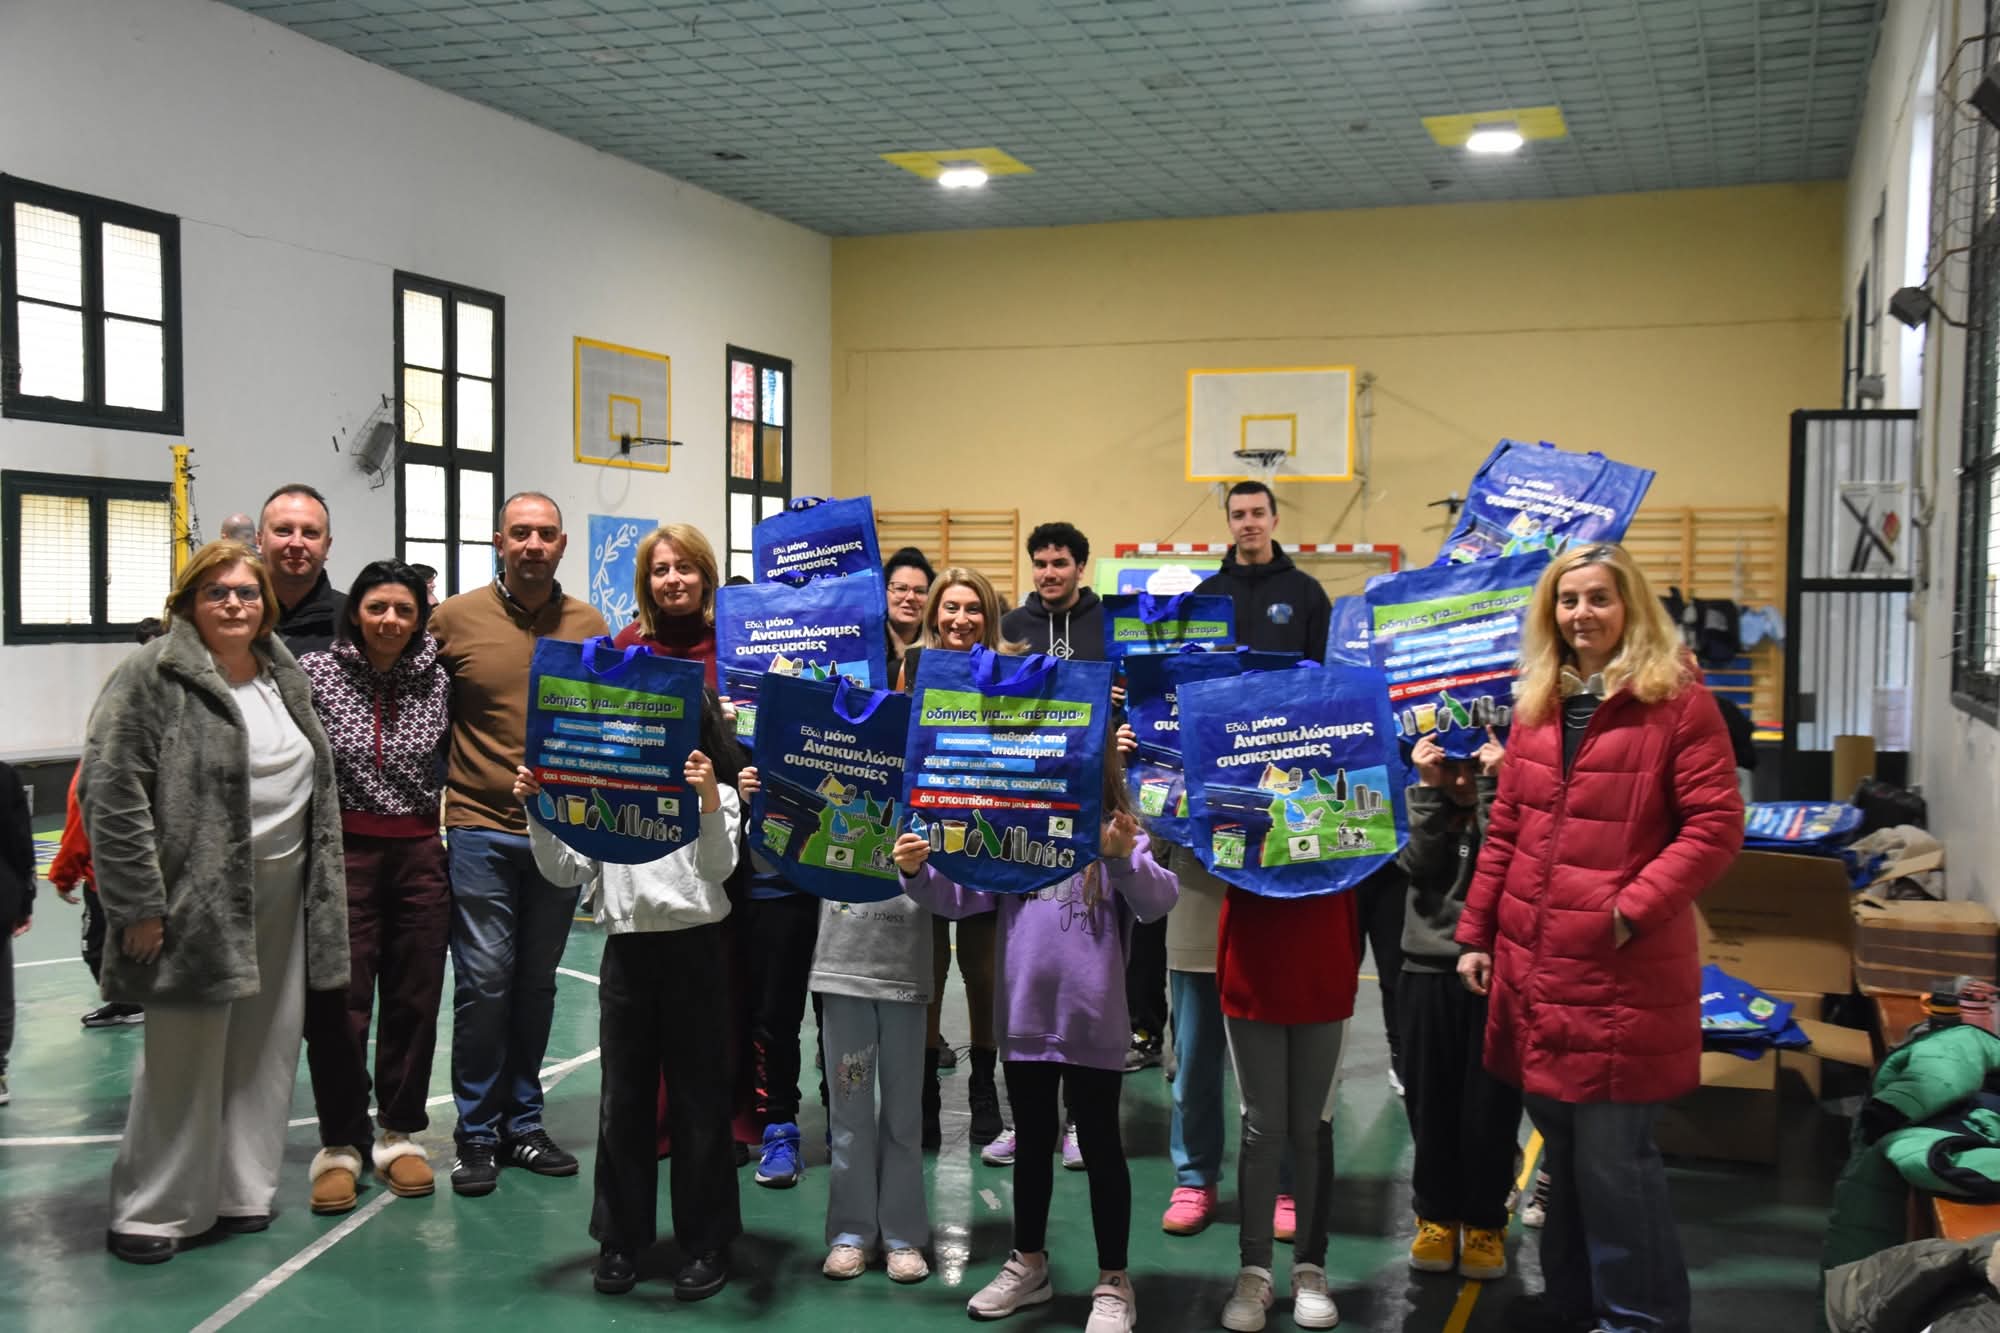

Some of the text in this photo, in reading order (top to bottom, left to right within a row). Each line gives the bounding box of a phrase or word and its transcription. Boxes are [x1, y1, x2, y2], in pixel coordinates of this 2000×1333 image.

[776, 540, 863, 565] Ανακυκλώσιμες
[787, 541, 809, 553] μόνο
[765, 616, 794, 629] μόνο
[750, 624, 861, 642] Ανακυκλώσιμες
[735, 639, 827, 656] συσκευασίες
[543, 694, 587, 709] οδηγίες
[926, 707, 1084, 724] οδηγίες για... «πέταμα»
[1251, 715, 1288, 732] μόνο
[823, 729, 857, 745] μόνο
[992, 731, 1041, 745] καθαρές
[1043, 732, 1068, 745] από
[1233, 720, 1375, 750] Ανακυκλώσιμες
[991, 745, 1065, 759] υπολείμματα
[1216, 741, 1333, 768] συσκευασίες
[783, 752, 889, 785] συσκευασίες
[928, 774, 1067, 793] όχι σε δεμένες σακούλες
[919, 793, 936, 805] όχι
[937, 794, 994, 808] σκουπίδια
